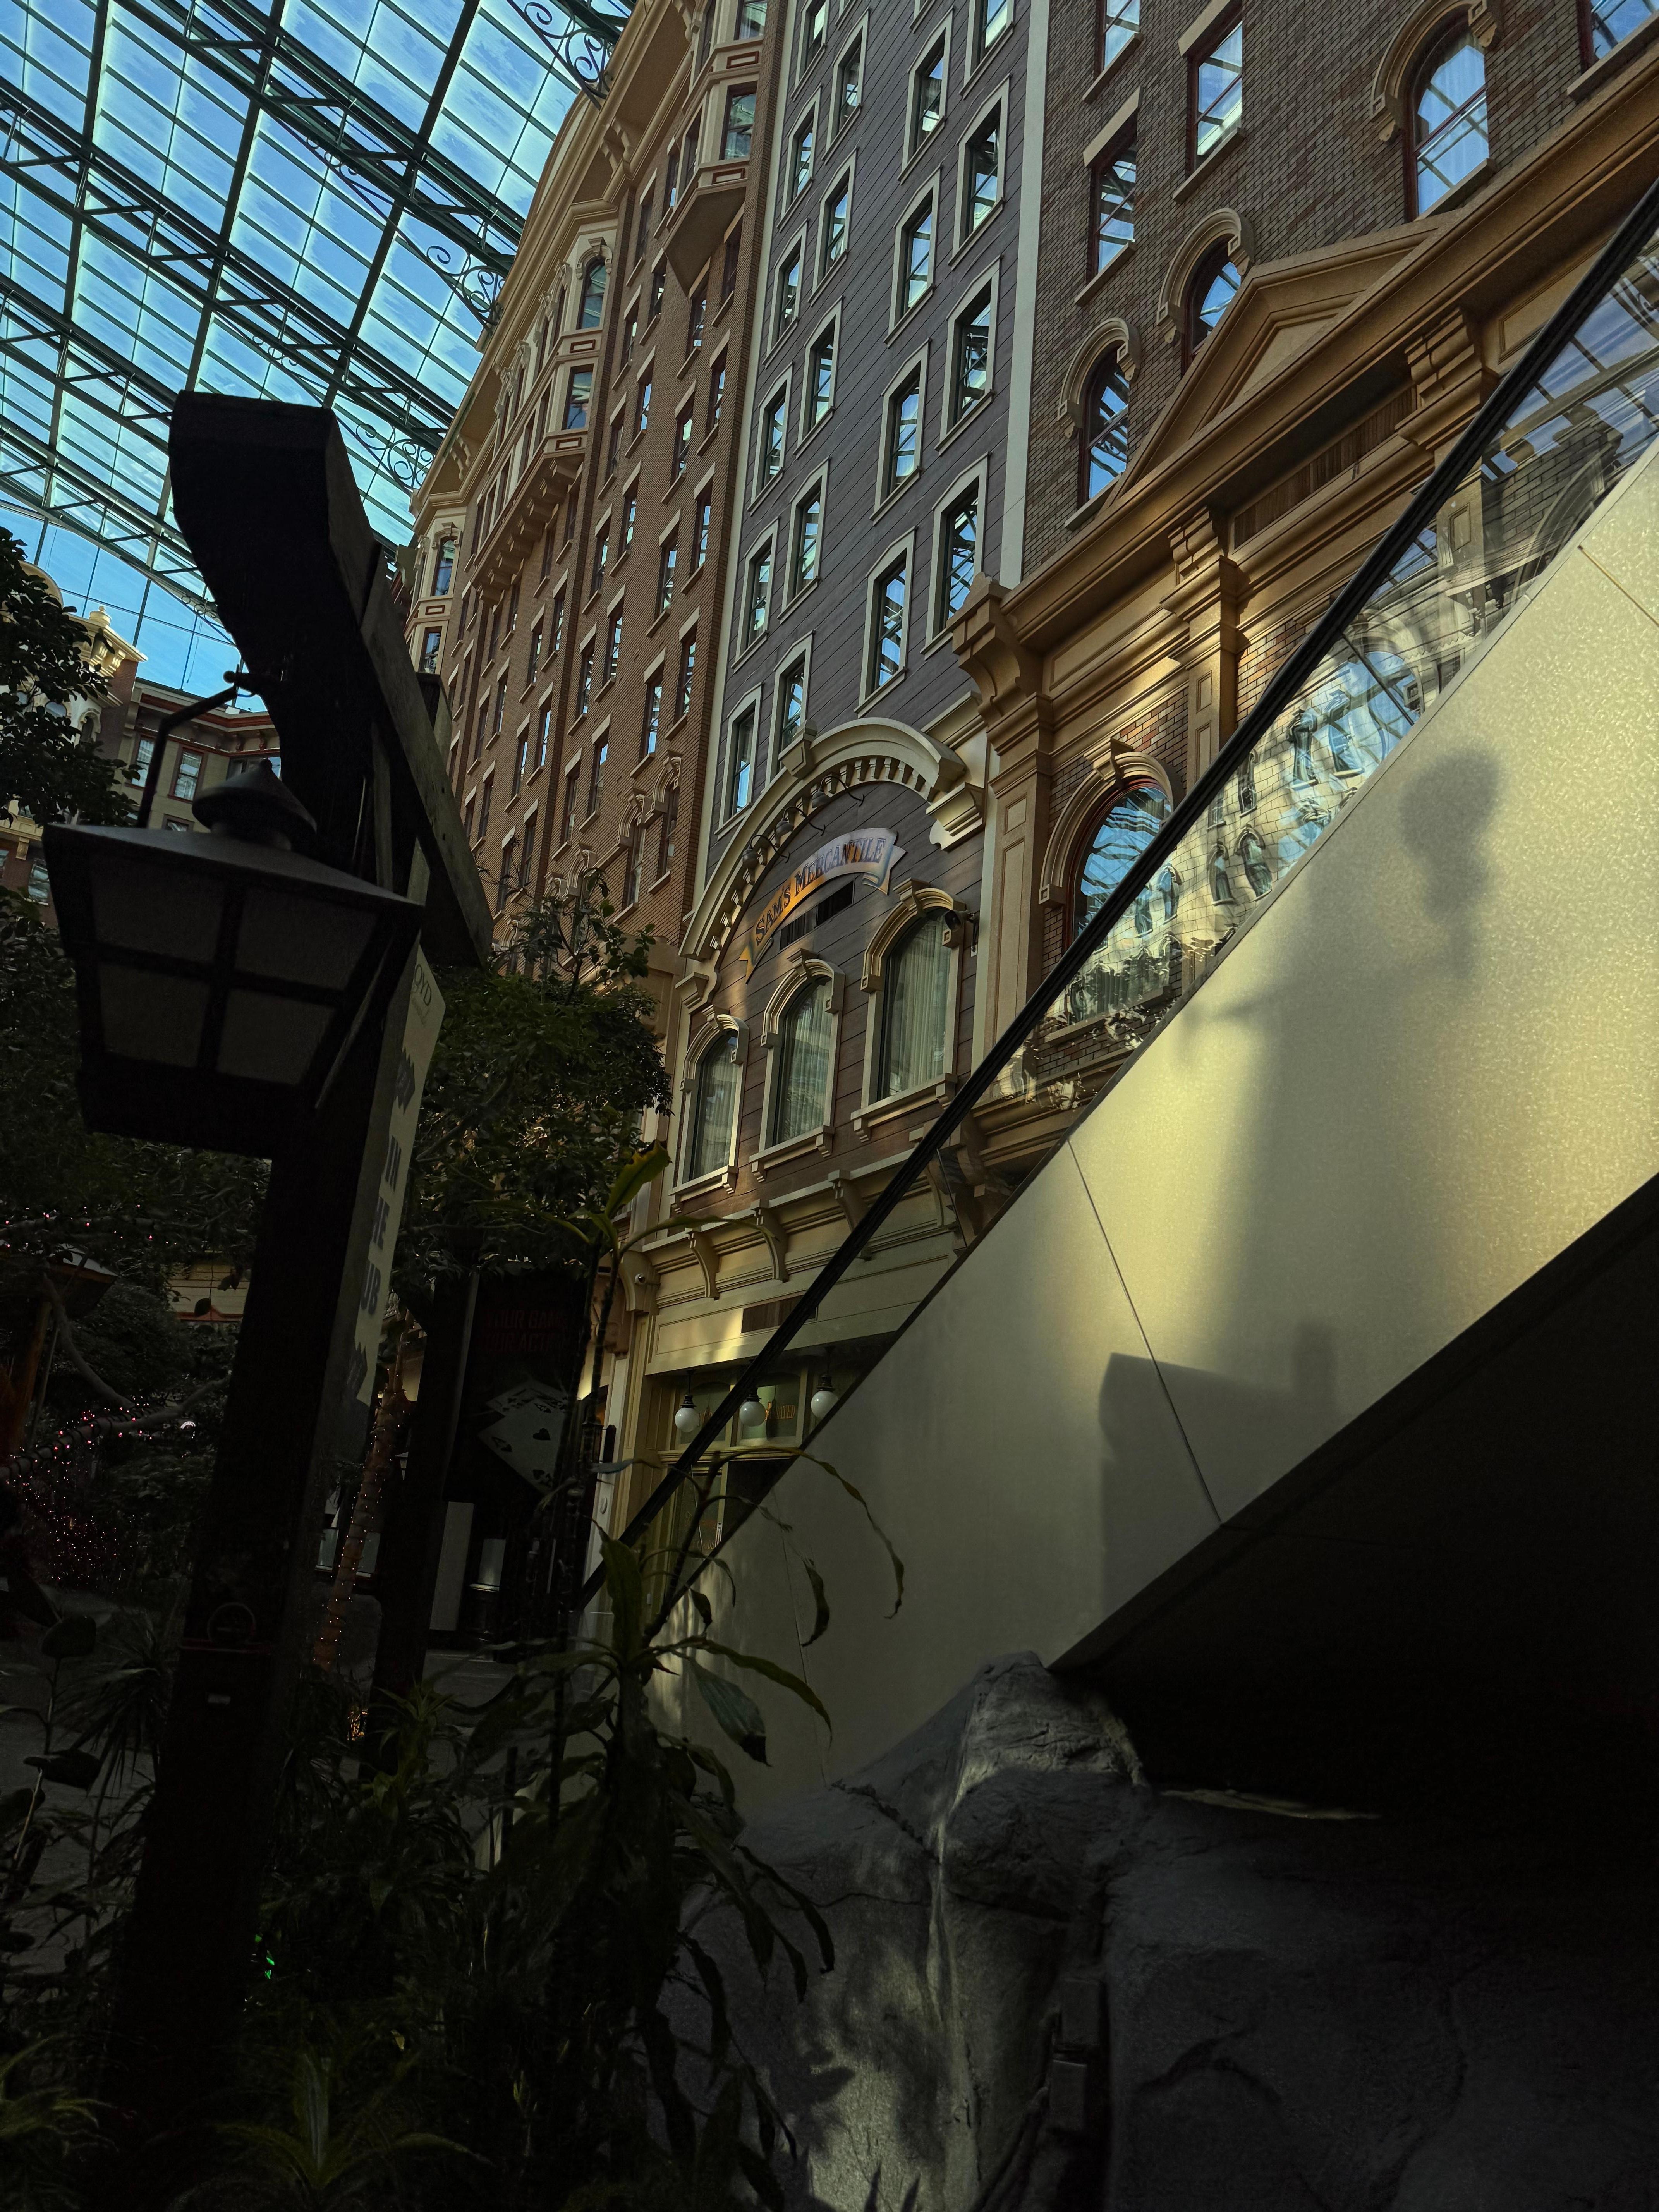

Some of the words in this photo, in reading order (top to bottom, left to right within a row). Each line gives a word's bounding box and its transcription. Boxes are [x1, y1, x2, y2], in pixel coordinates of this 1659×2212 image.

[755, 885, 792, 946] SAM'S
[794, 838, 887, 896] MERCANTILE
[414, 964, 432, 1006] OYD
[361, 1263, 381, 1314] UB
